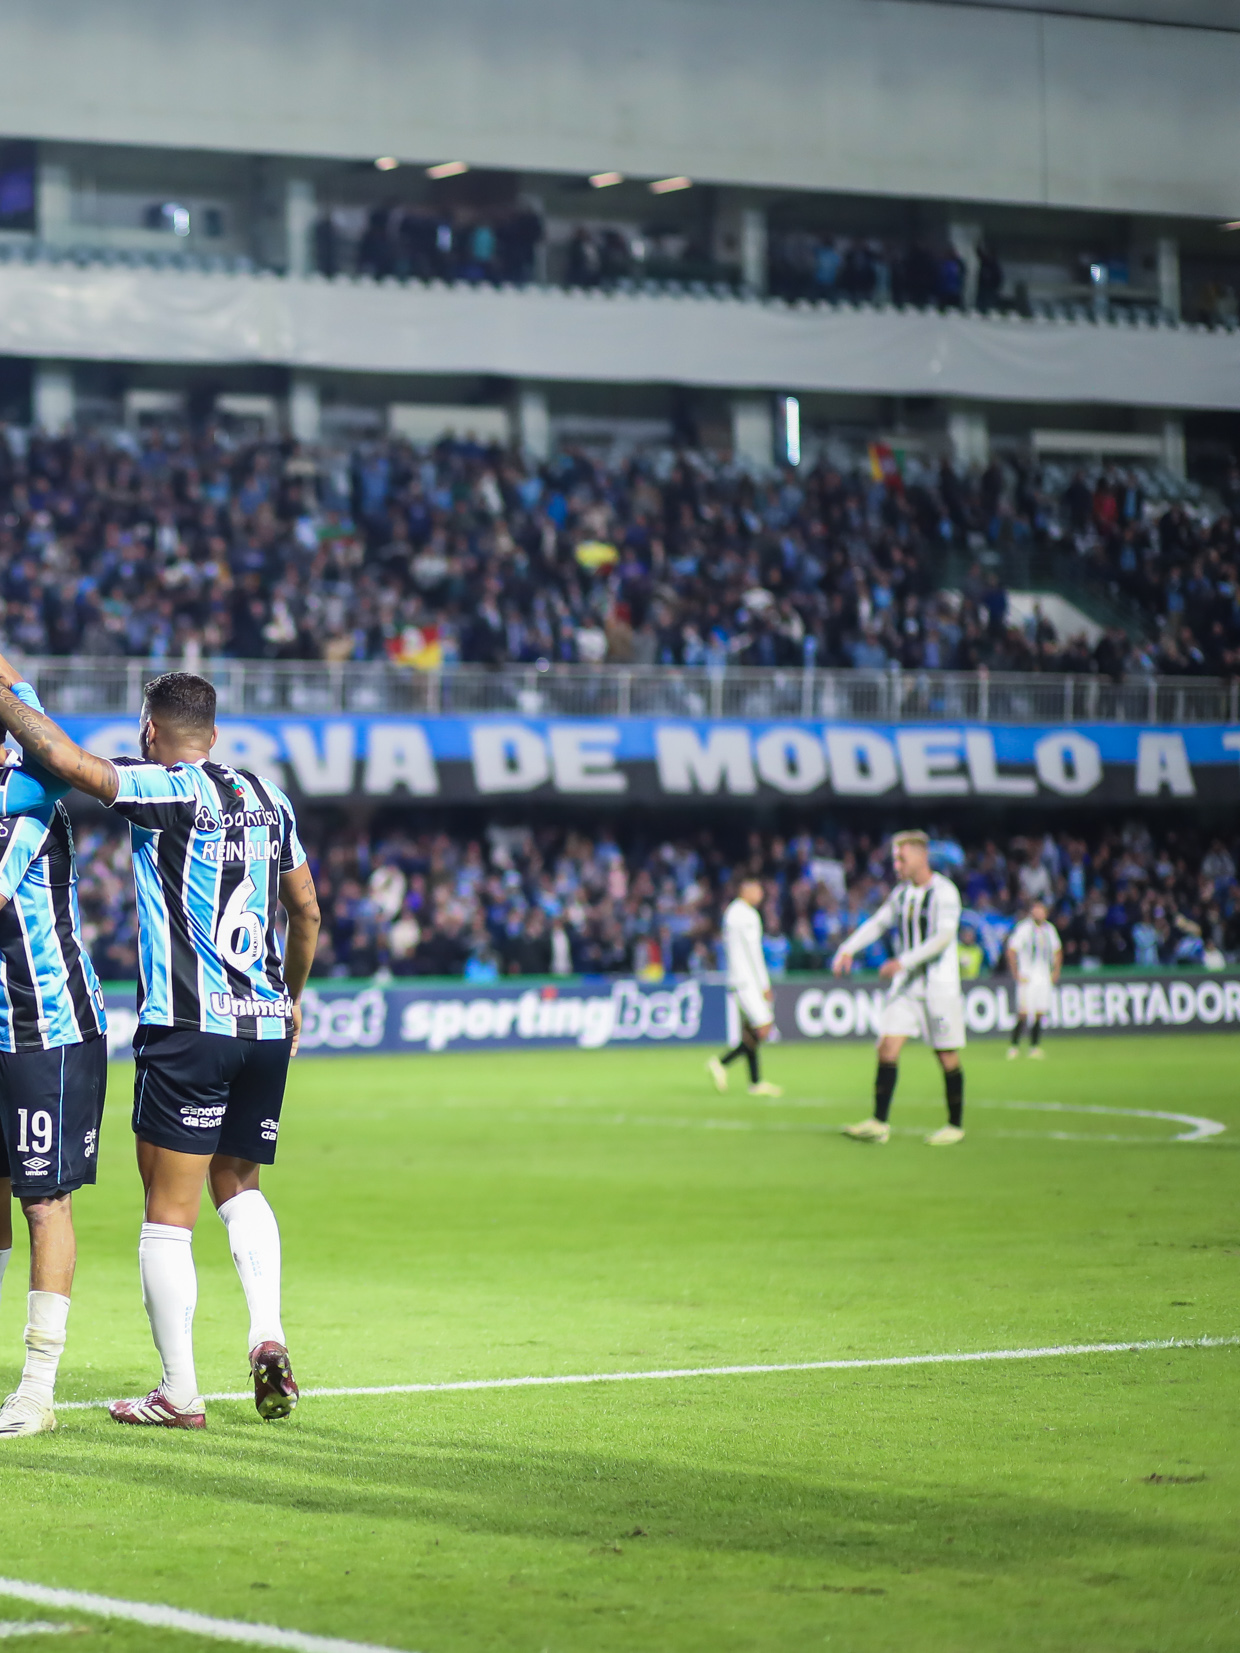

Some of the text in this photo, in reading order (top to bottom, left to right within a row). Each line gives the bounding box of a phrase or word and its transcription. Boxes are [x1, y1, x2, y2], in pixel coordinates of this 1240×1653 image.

[471, 724, 628, 793] DE
[655, 725, 1103, 798] MODELO
[1135, 731, 1197, 798] A
[202, 840, 280, 861] REINALDO
[216, 874, 263, 973] 6
[401, 979, 703, 1051] sportingbet
[1044, 980, 1240, 1029] IBERTADOR
[17, 1108, 53, 1154] 19
